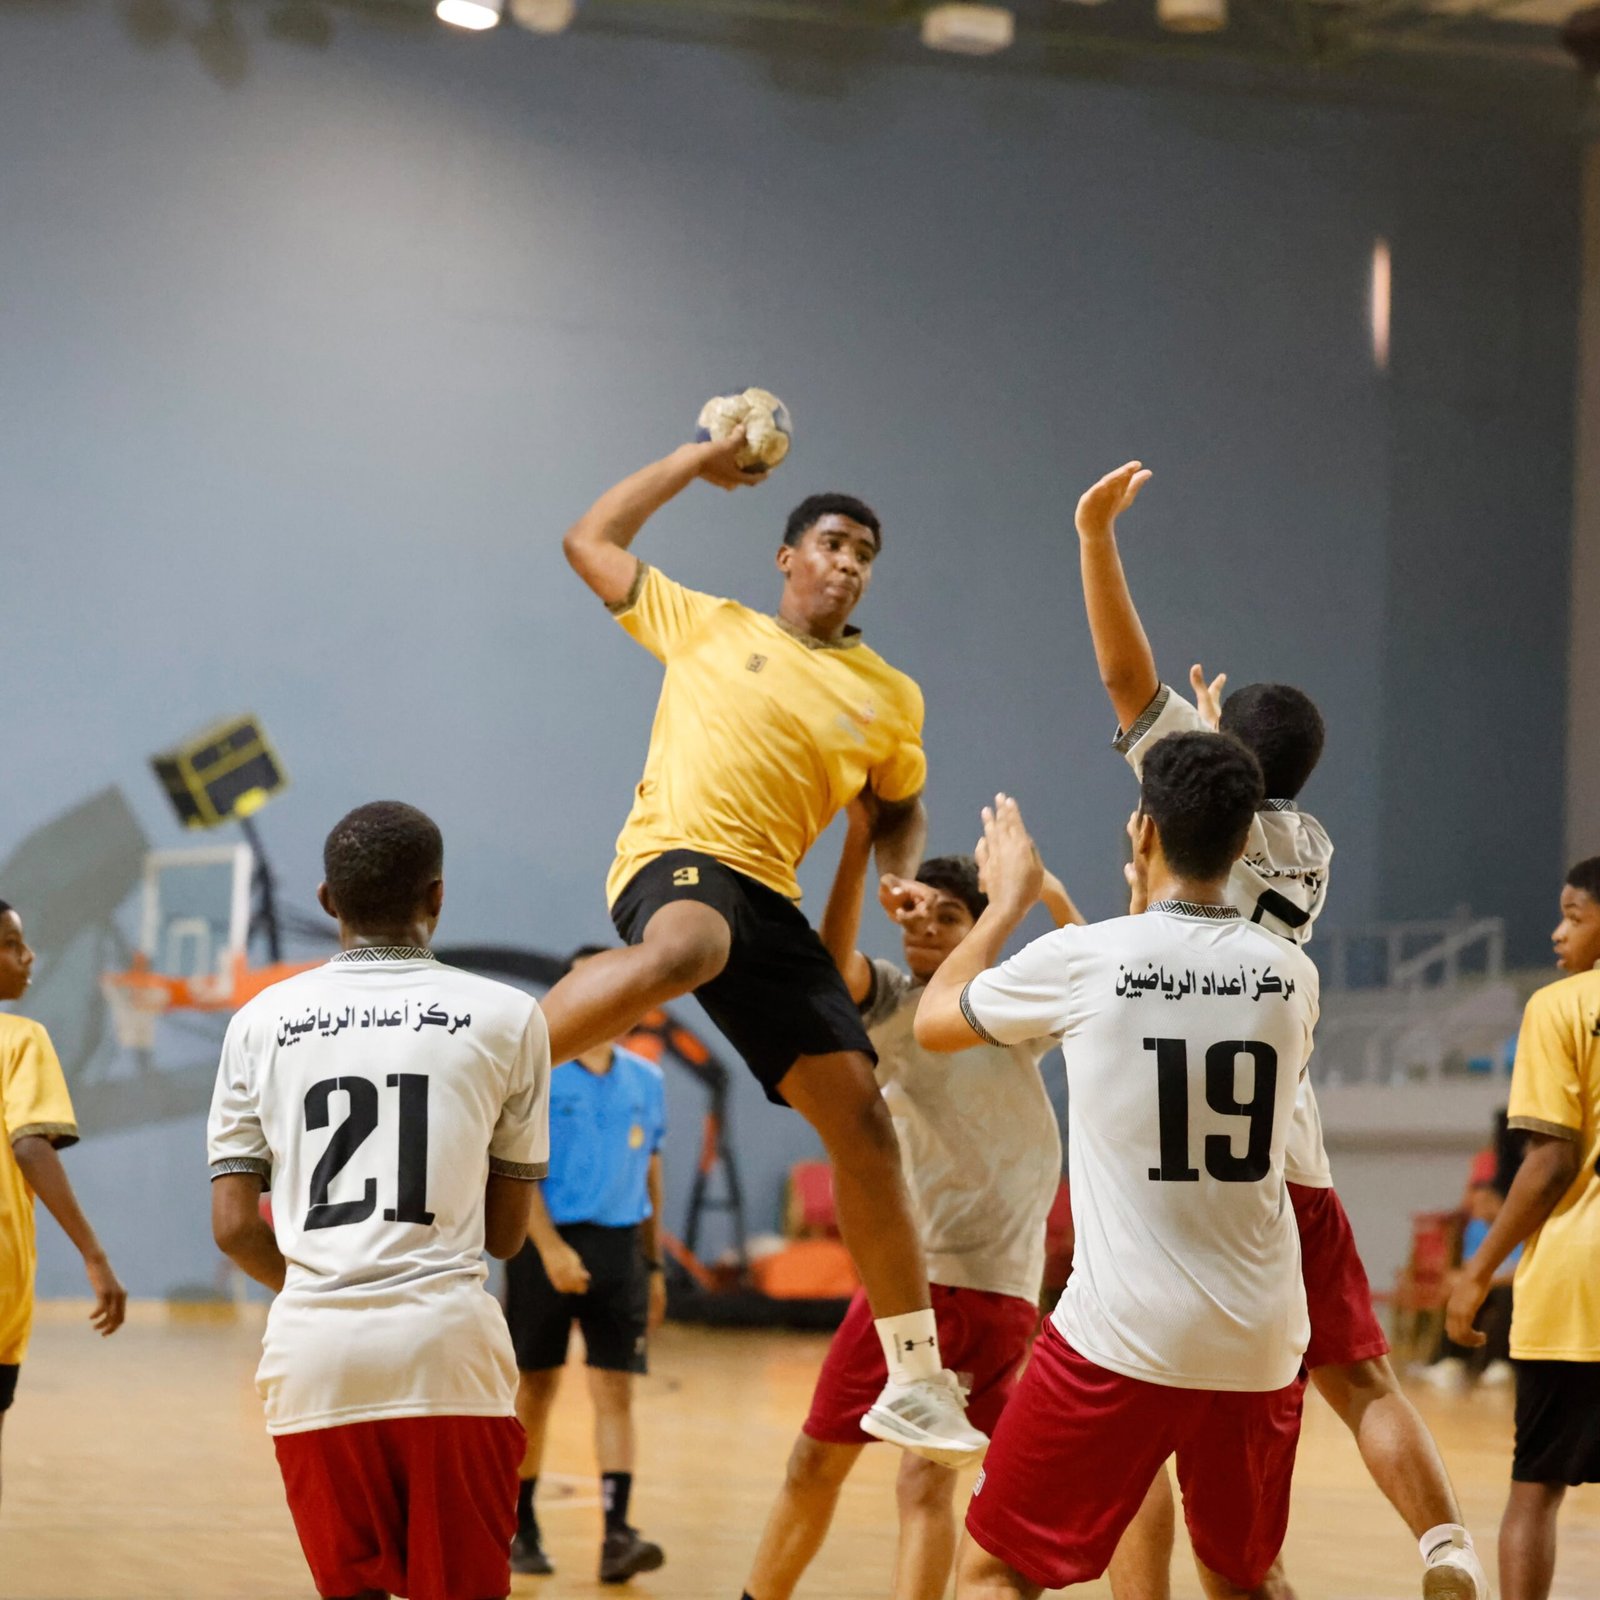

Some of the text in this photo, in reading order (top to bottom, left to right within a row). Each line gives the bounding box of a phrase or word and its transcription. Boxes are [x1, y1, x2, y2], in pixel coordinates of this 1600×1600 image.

[673, 866, 699, 886] 3
[1115, 962, 1196, 1001] الرياضيين
[1201, 964, 1247, 996] أعداد
[277, 1005, 355, 1047] الرياضيين
[413, 1002, 471, 1035] مركز
[1143, 1037, 1278, 1183] 19
[303, 1073, 435, 1231] 21
